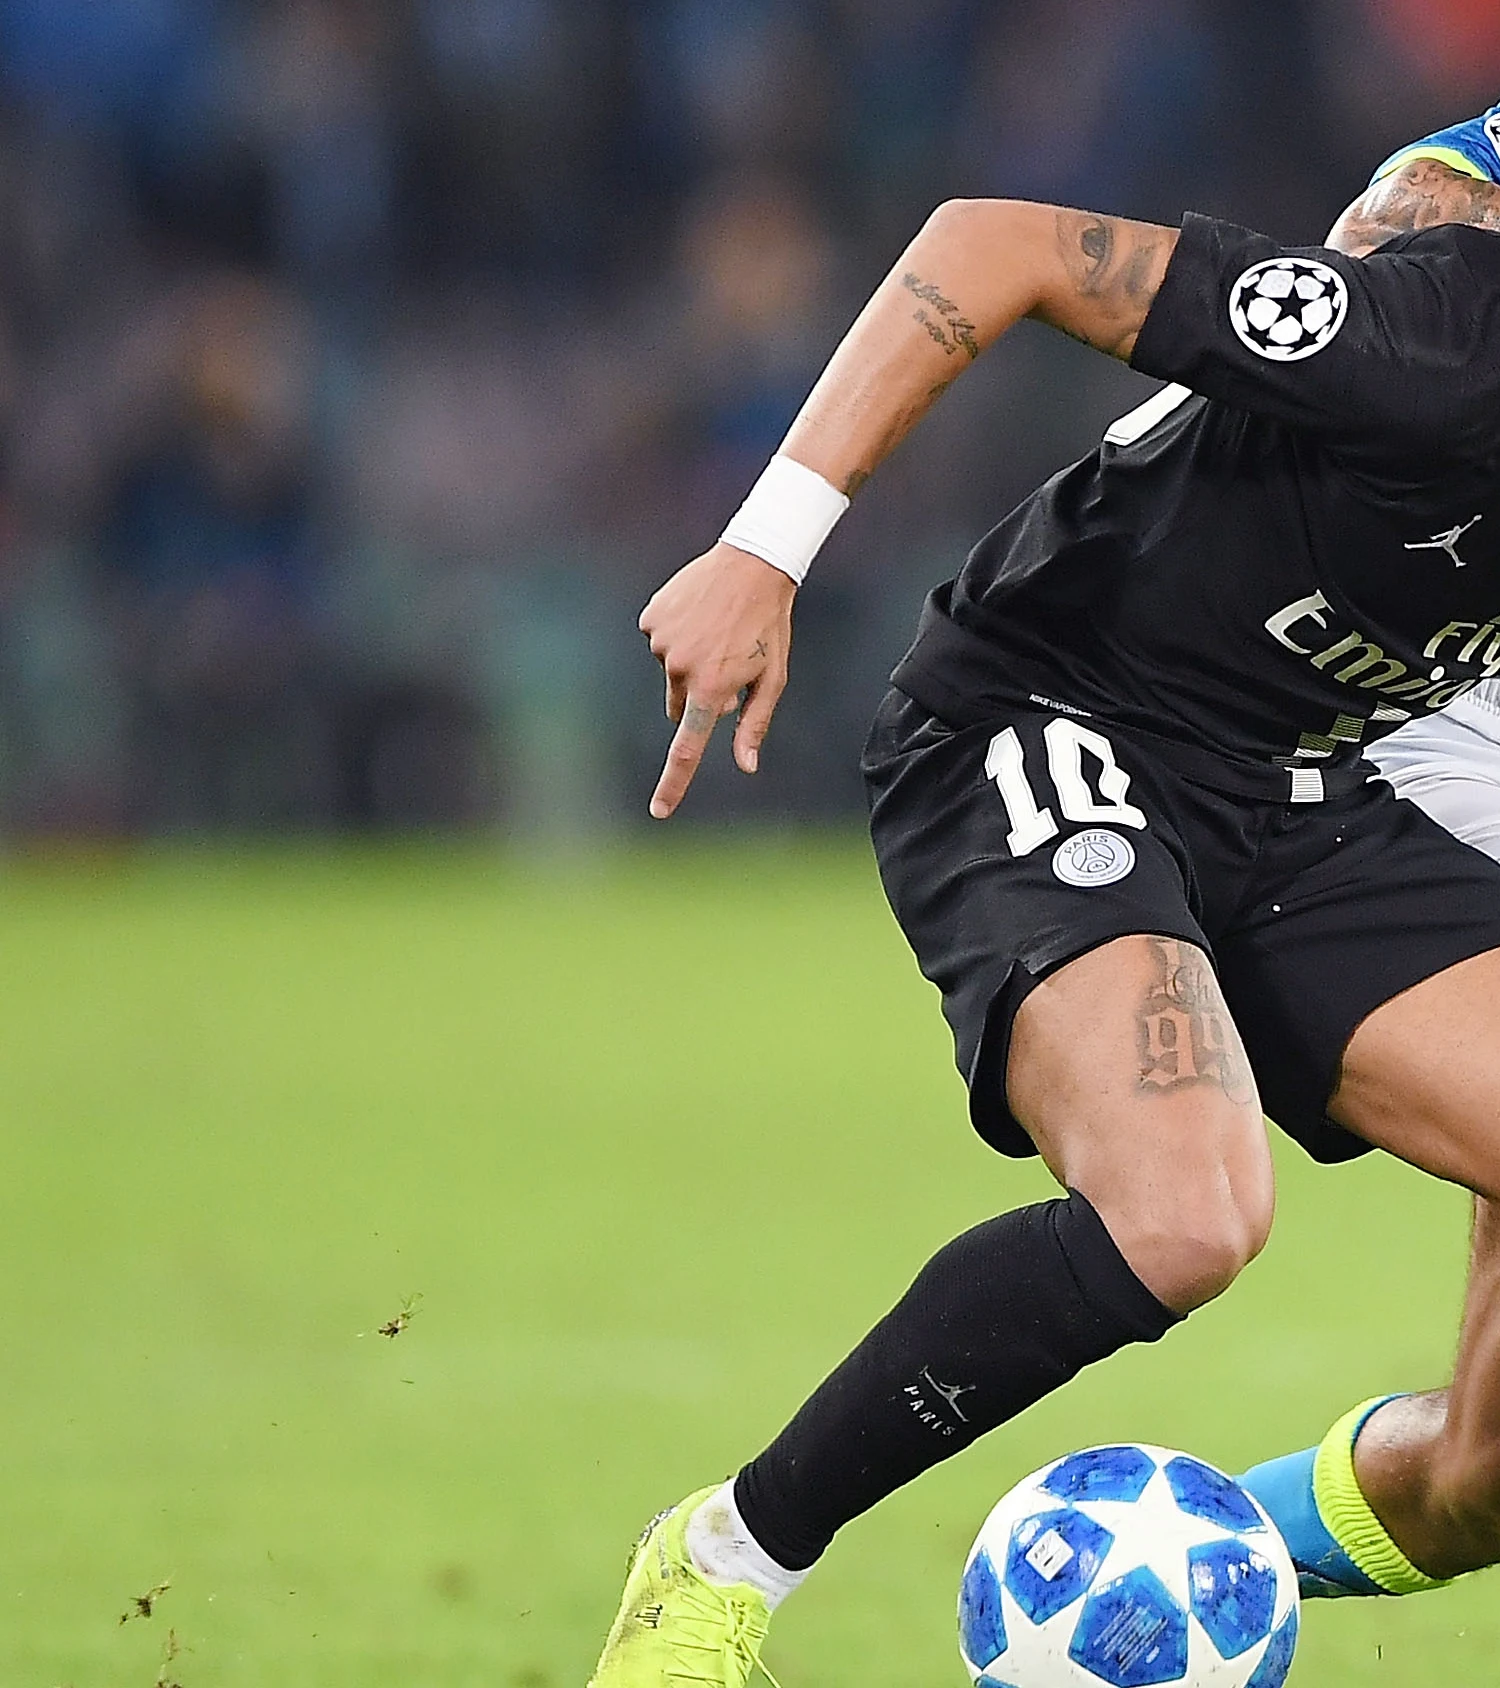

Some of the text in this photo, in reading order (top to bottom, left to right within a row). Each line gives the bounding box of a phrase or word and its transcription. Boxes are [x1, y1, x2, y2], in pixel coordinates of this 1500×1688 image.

[984, 718, 1148, 858] 10
[1063, 834, 1109, 855] PARIS
[903, 1384, 956, 1437] PARIS
